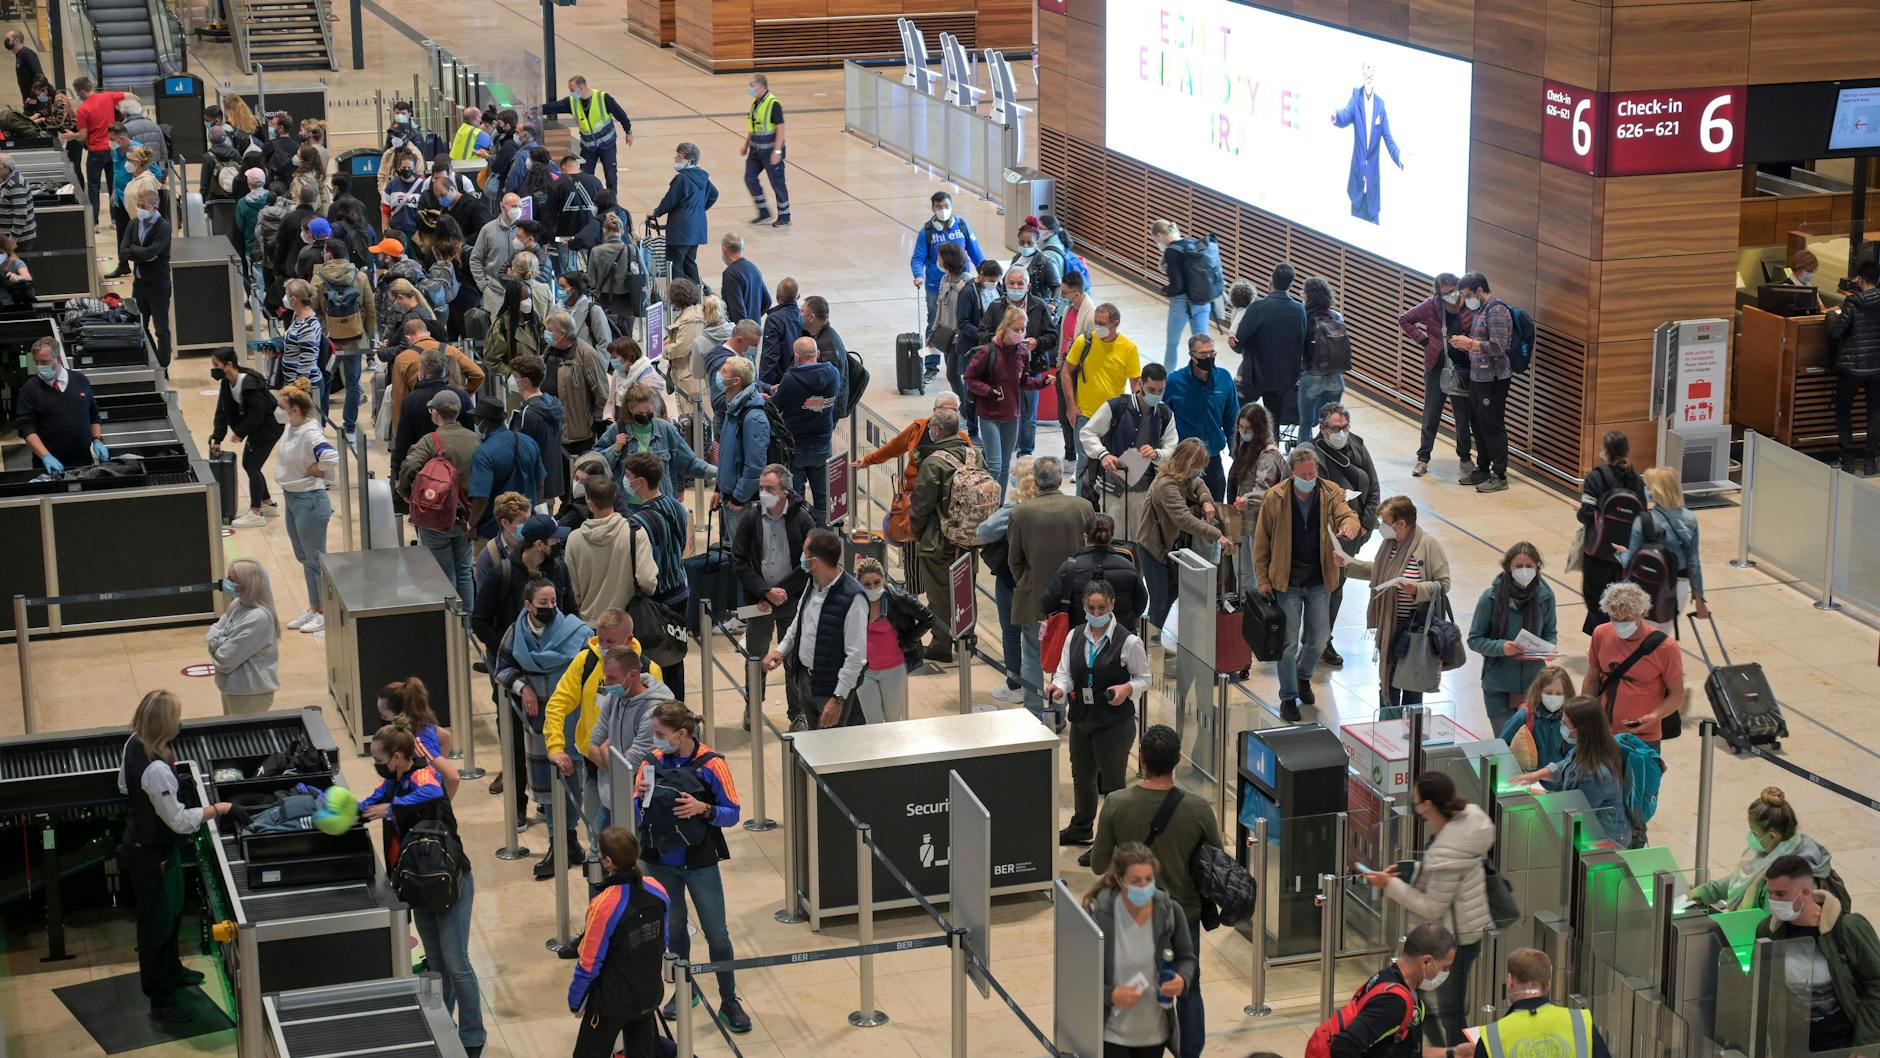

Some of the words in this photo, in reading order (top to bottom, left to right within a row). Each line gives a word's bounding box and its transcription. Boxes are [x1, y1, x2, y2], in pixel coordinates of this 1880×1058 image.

[1547, 89, 1571, 105] Check-in
[1617, 98, 1683, 117] Check-in
[1572, 98, 1592, 156] 6
[1699, 94, 1734, 153] 6
[994, 863, 1015, 875] BER
[896, 941, 913, 950] BER
[791, 953, 809, 962] BER
[690, 965, 702, 973] ER
